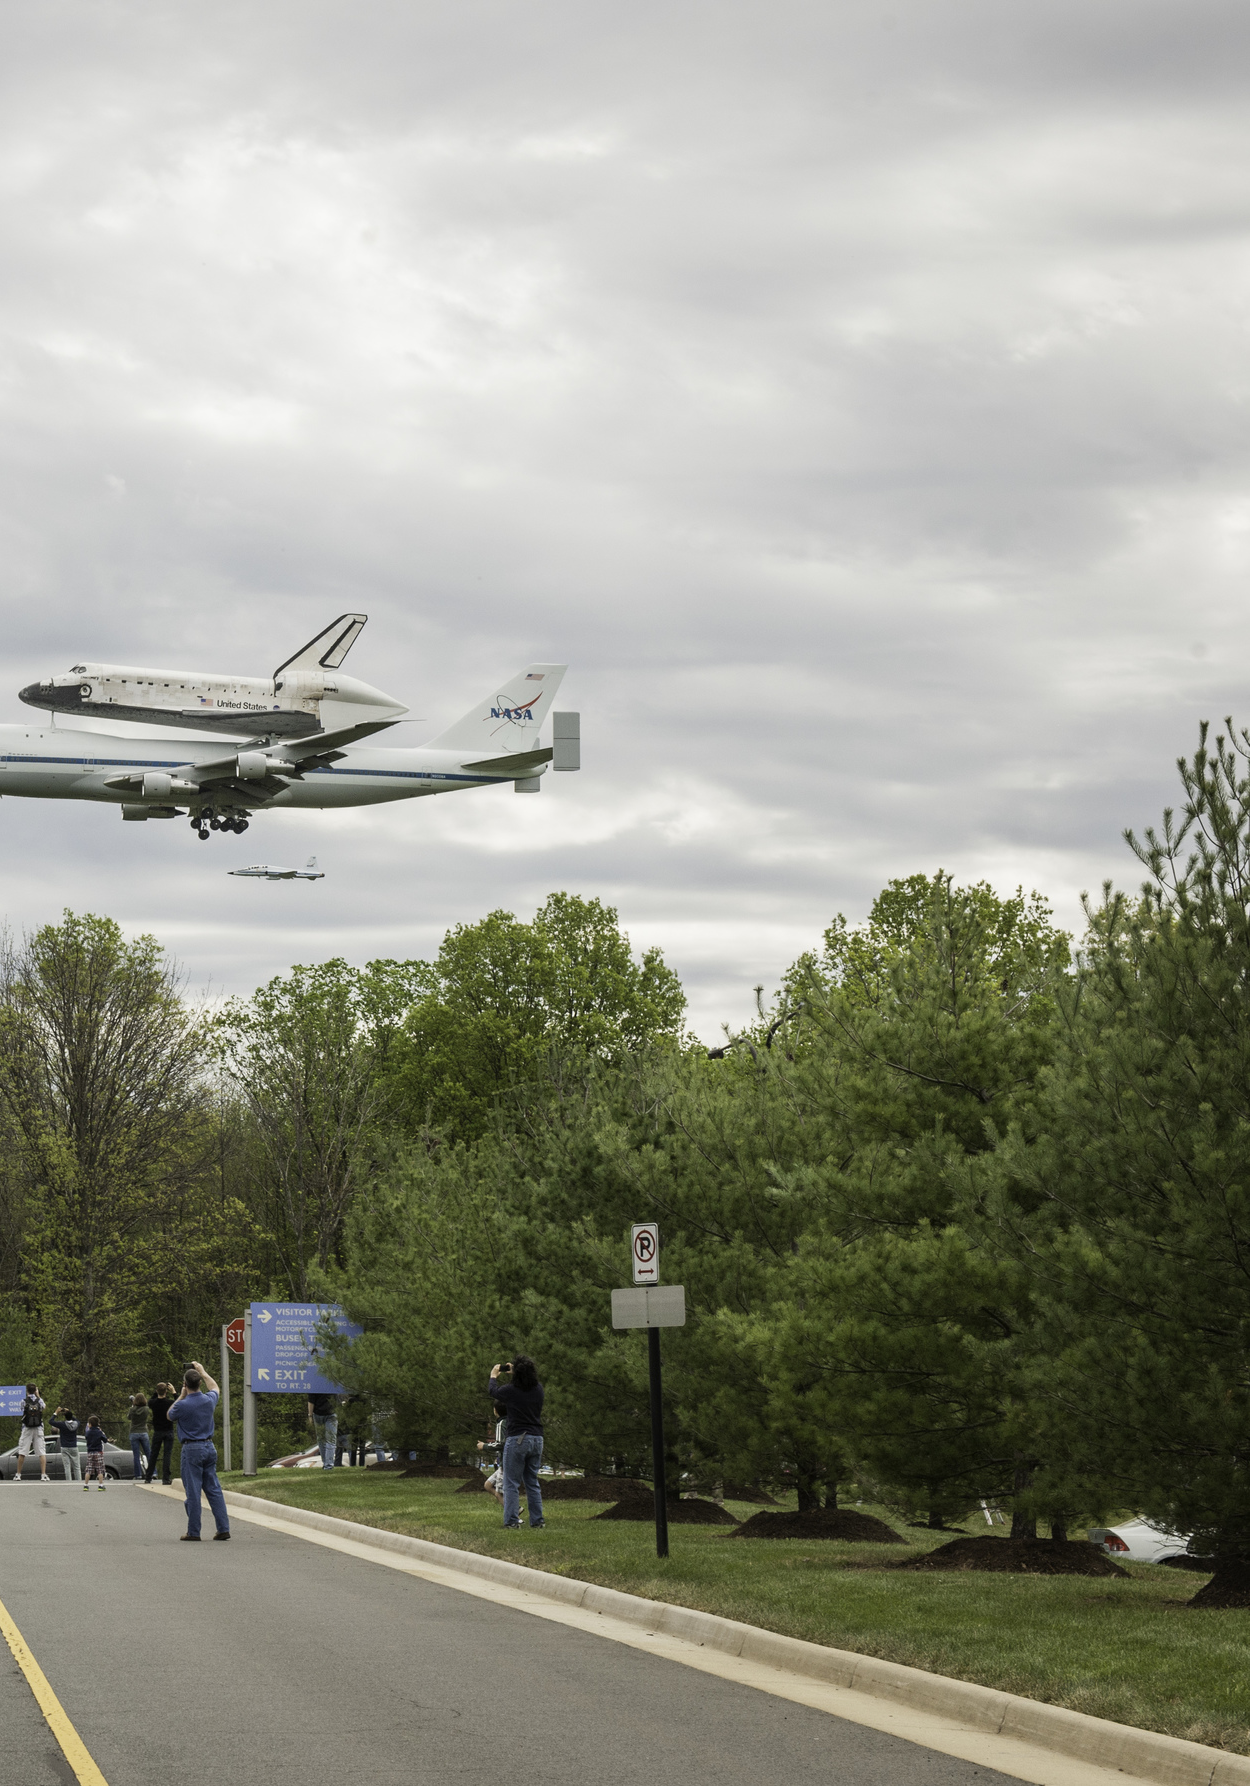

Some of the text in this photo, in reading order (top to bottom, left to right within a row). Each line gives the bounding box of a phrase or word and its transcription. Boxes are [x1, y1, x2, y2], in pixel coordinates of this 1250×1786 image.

[217, 699, 267, 711] United States
[490, 707, 533, 720] NASA
[275, 1308, 345, 1317] VISITOR PARKI
[228, 1329, 245, 1343] ST
[275, 1369, 307, 1380] EXIT
[303, 1382, 311, 1390] 28
